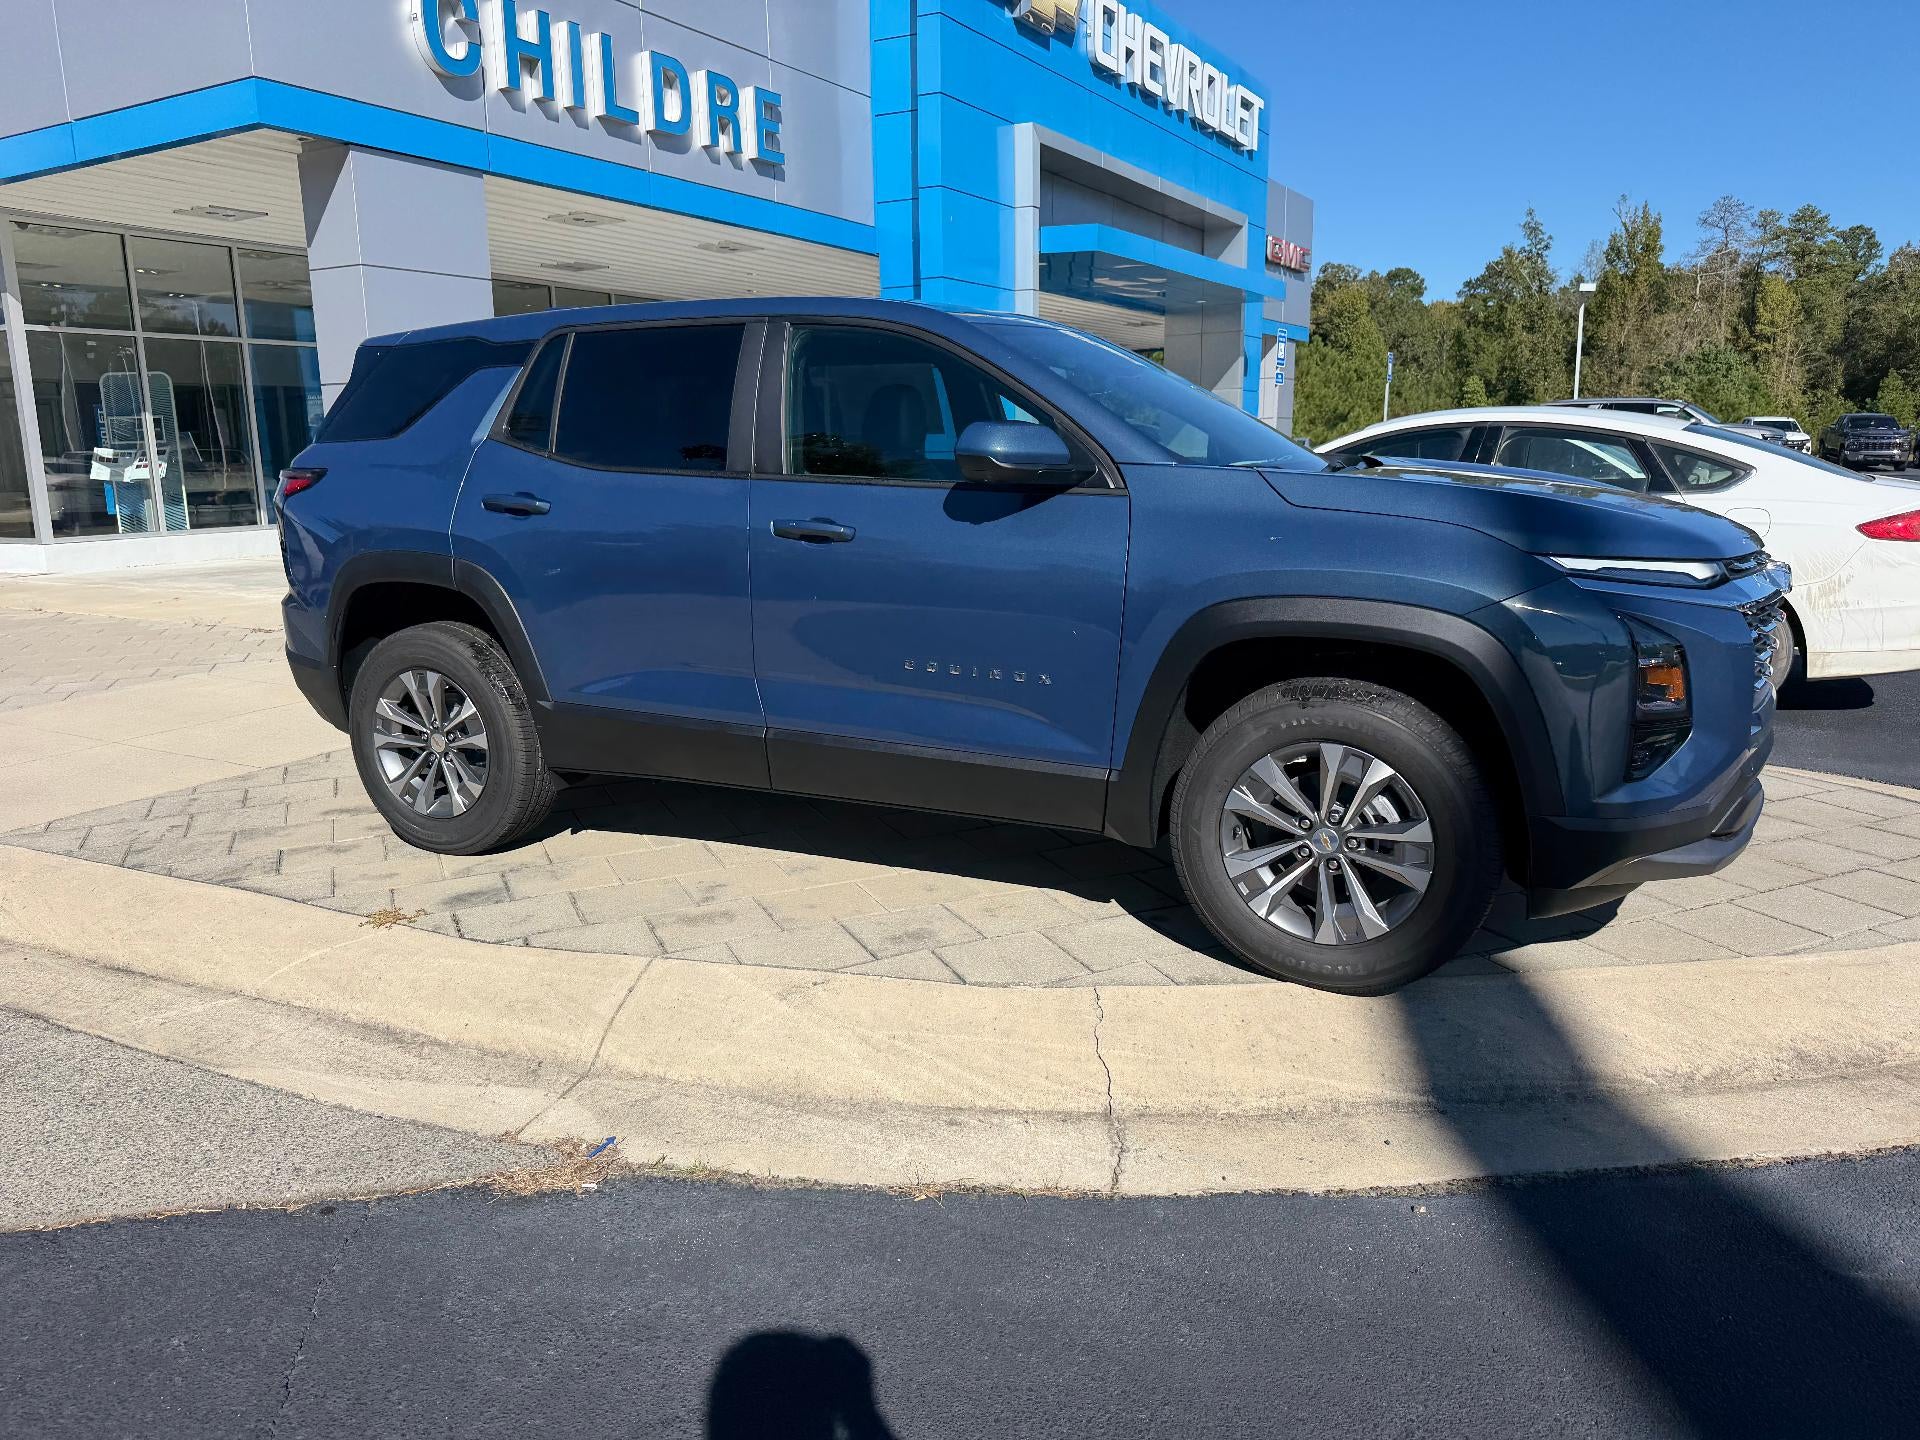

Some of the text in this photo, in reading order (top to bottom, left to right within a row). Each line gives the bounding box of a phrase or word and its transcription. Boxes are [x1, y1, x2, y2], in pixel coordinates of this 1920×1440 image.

[414, 0, 785, 165] CHILDRE
[1089, 0, 1264, 151] CHEVROLET
[1267, 236, 1311, 272] GMC
[904, 659, 1051, 685] EQUINOX
